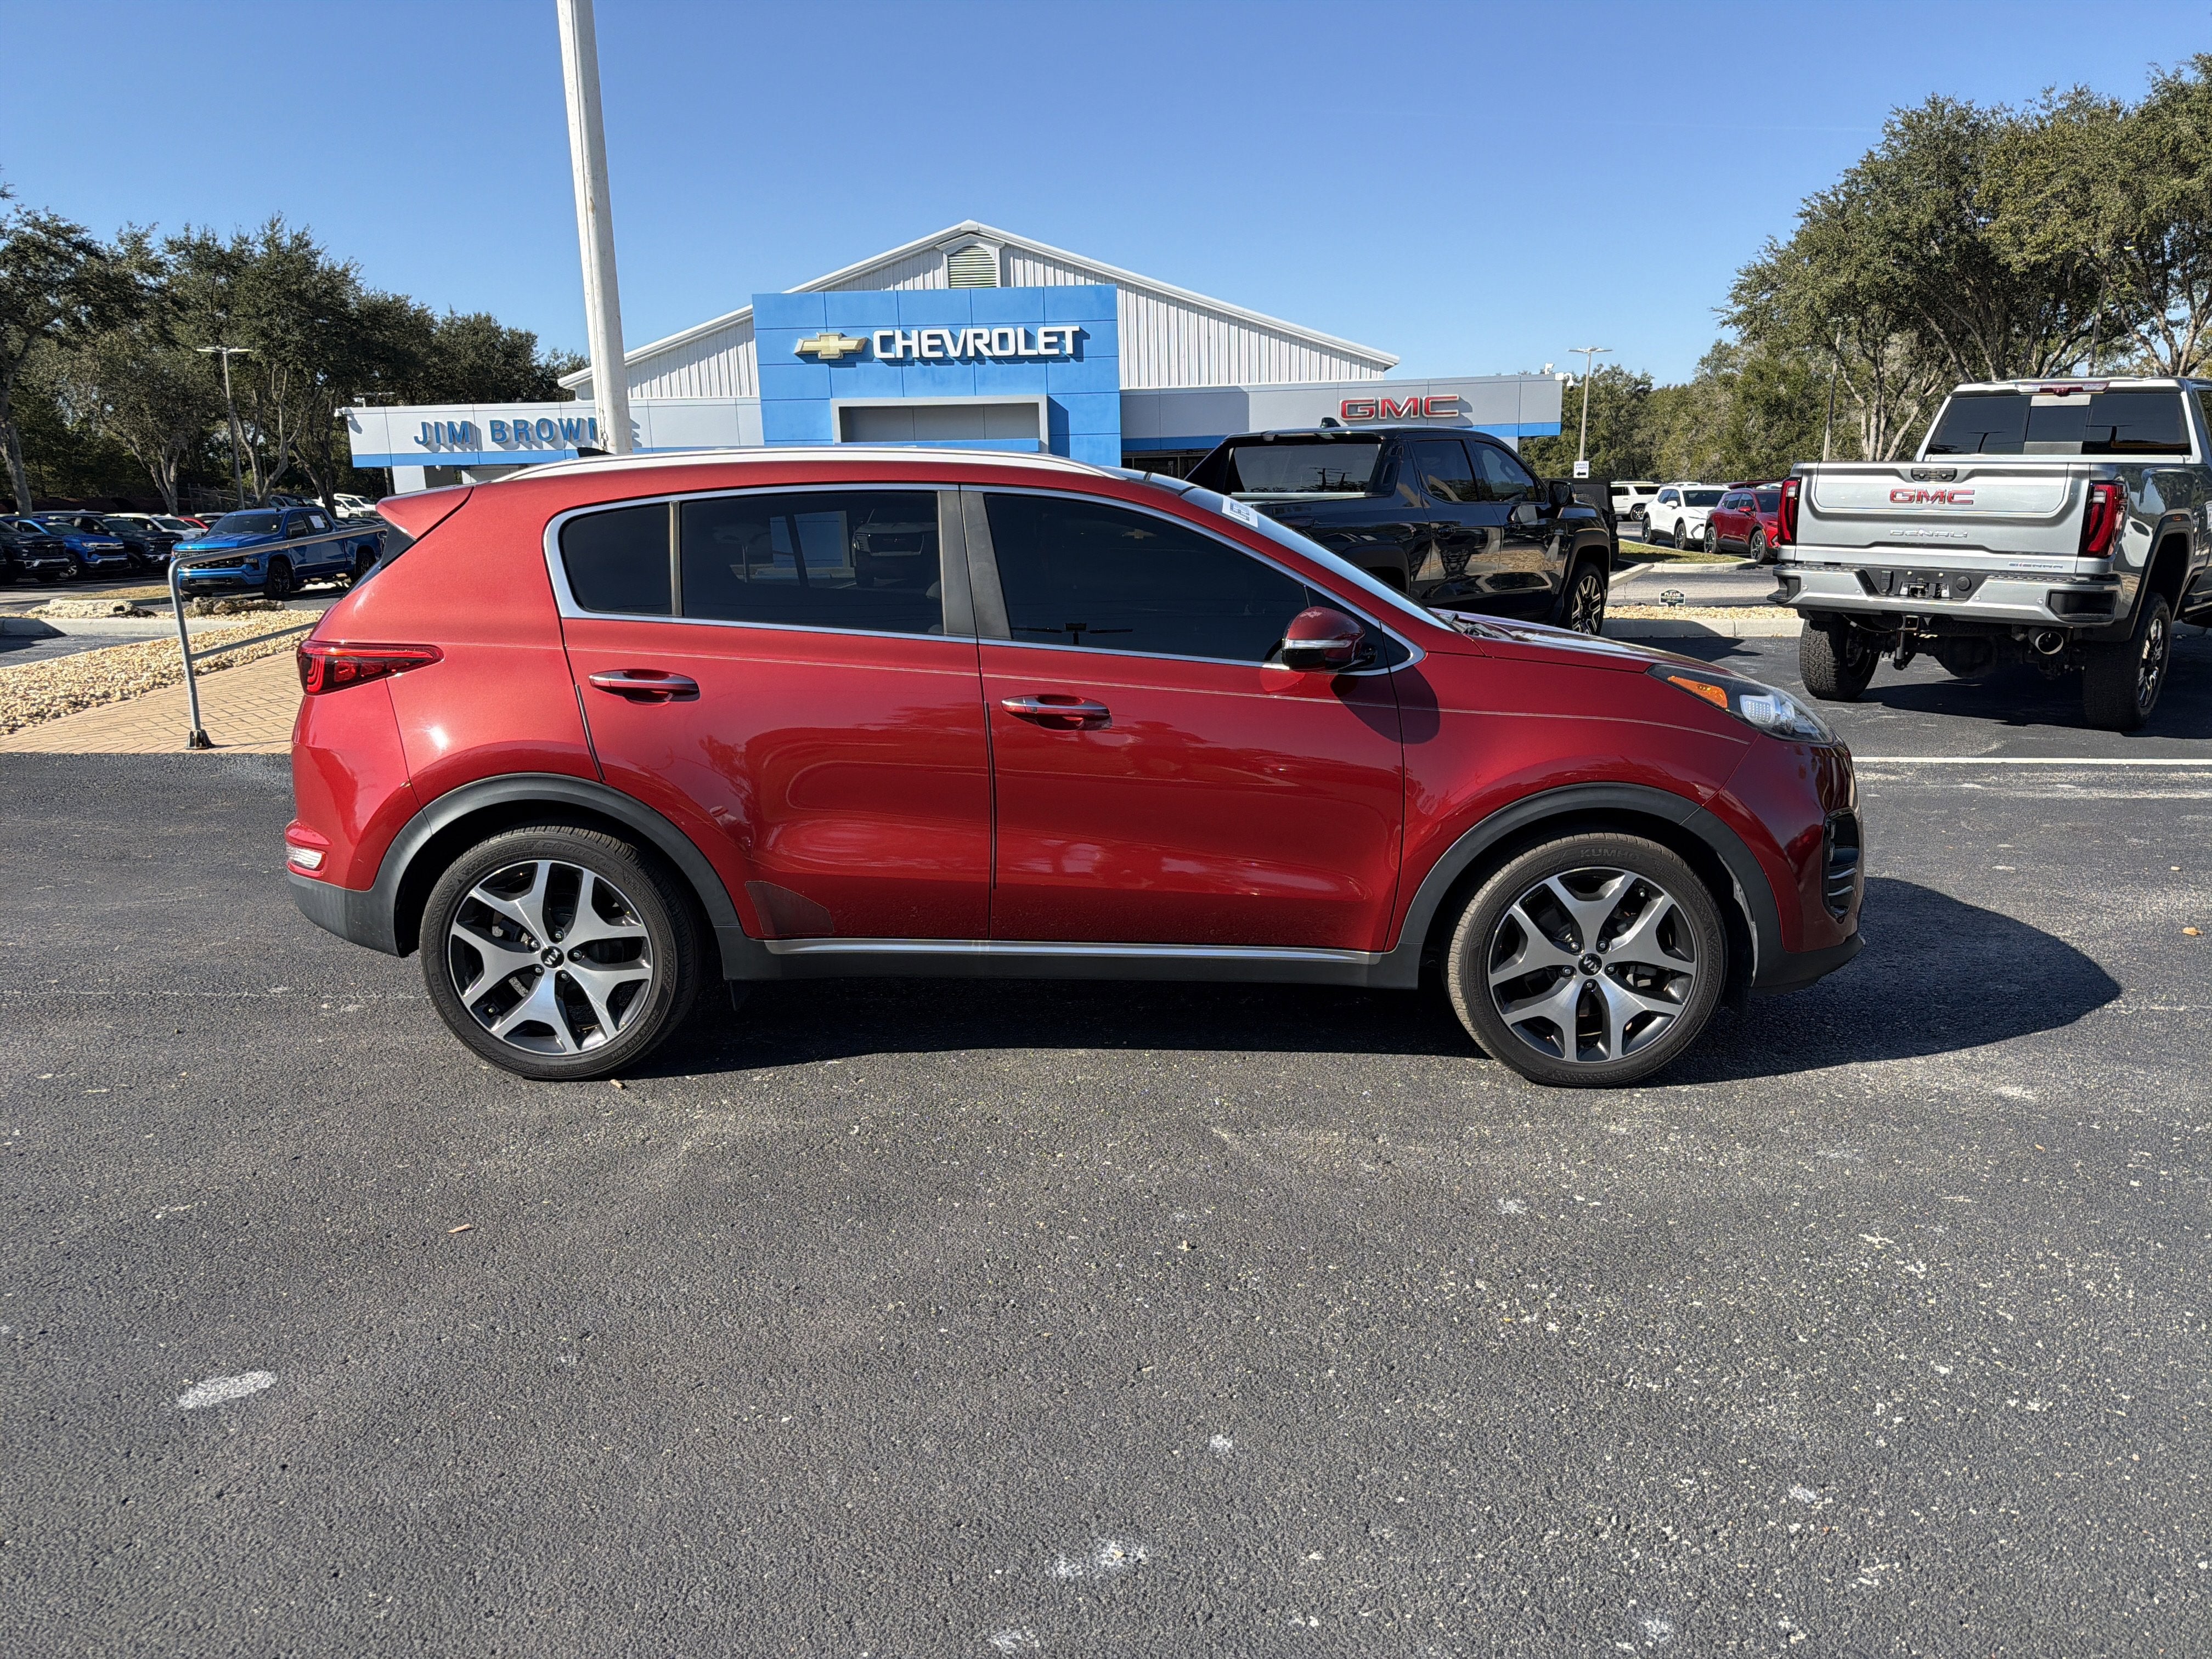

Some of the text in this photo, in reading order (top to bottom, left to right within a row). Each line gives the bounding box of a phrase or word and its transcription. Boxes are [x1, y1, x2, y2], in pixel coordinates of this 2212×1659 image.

[873, 325, 1080, 358] CHEVROLET
[1340, 394, 1459, 421] GMC
[414, 420, 470, 445] JIM
[1890, 488, 1975, 505] GMC
[1890, 529, 1968, 538] DENALI
[1581, 848, 1639, 861] KUMHO
[544, 949, 561, 966] KIA
[1583, 956, 1600, 973] KIA
